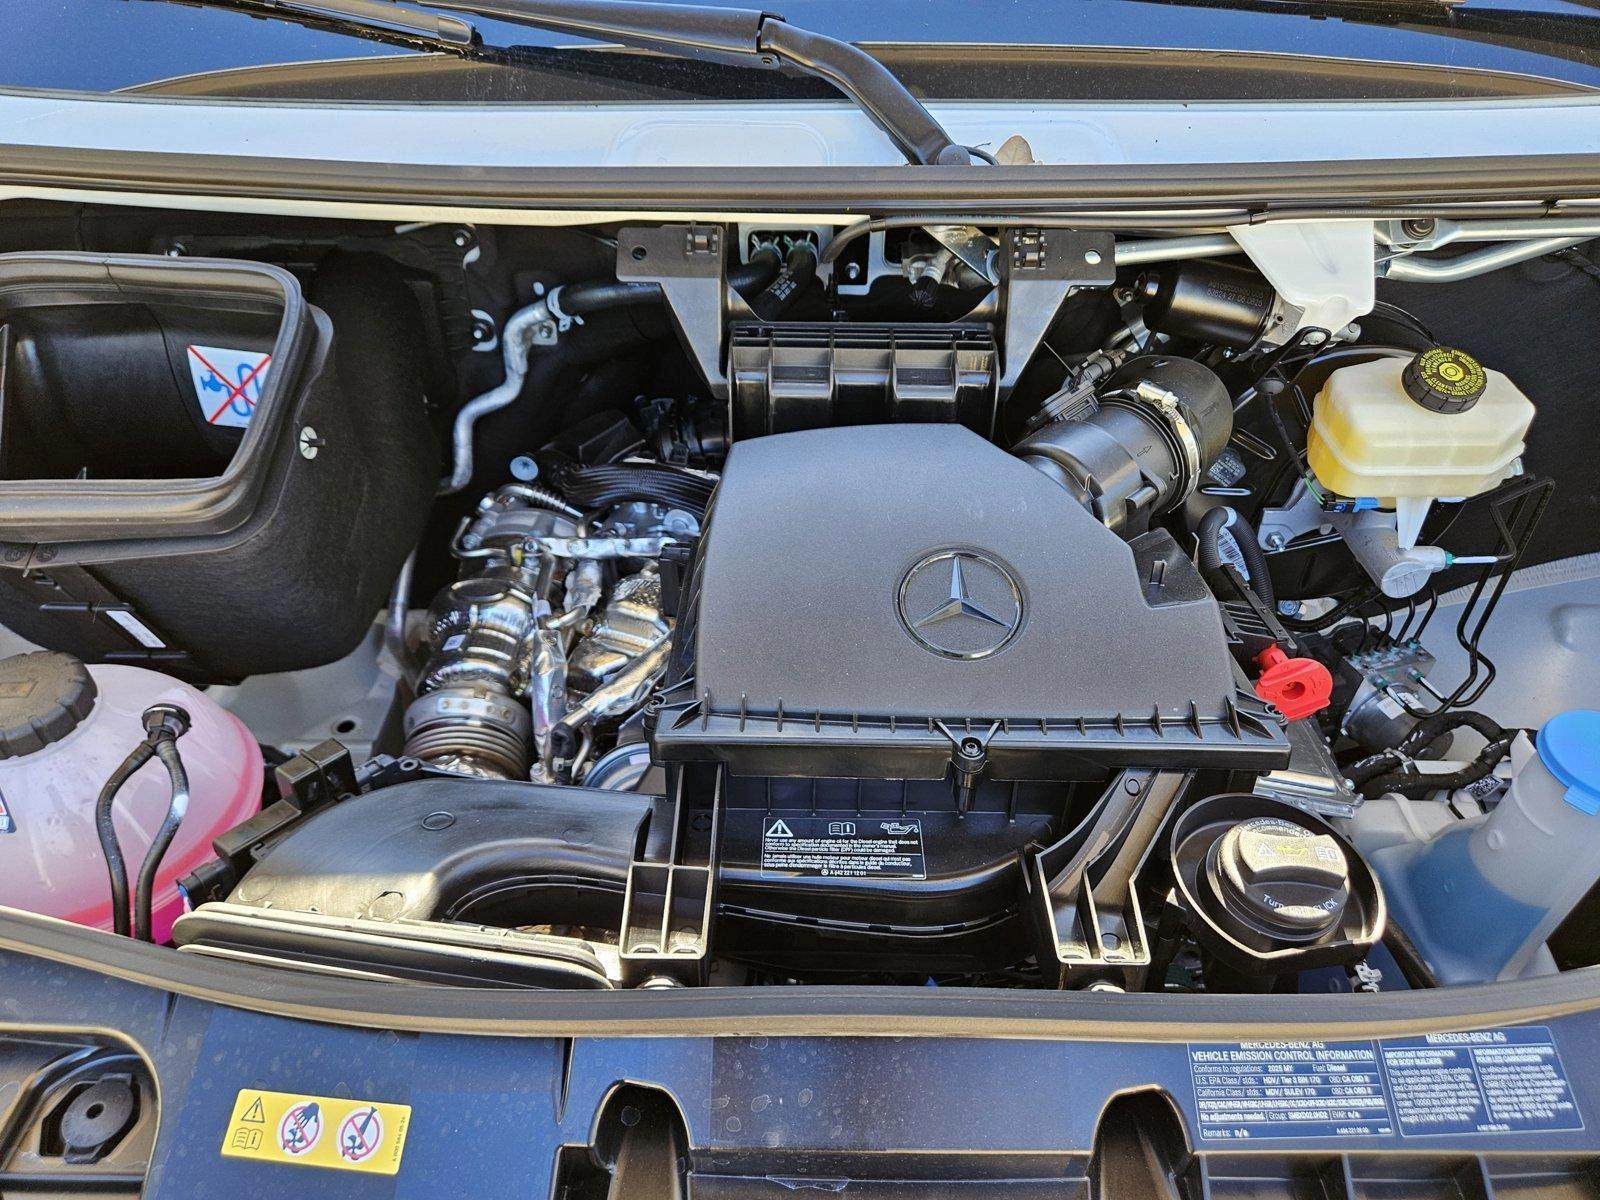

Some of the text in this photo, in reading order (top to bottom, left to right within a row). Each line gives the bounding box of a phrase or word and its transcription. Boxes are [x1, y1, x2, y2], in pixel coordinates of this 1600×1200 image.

[1253, 825, 1306, 839] ecommended
[1426, 1032, 1507, 1043] MERCEDES-BENZ AG
[1240, 1041, 1324, 1049] MERCEDES-BENZ AG
[1192, 1050, 1374, 1061] VEHICLE EMISSION CONTROL INFORMATION
[1230, 1064, 1263, 1074] regulations:
[1268, 1064, 1283, 1072] 2025
[1310, 1076, 1321, 1084] 170
[1210, 1112, 1243, 1121] adjustments
[1203, 1128, 1249, 1137] Remarks: n/a
